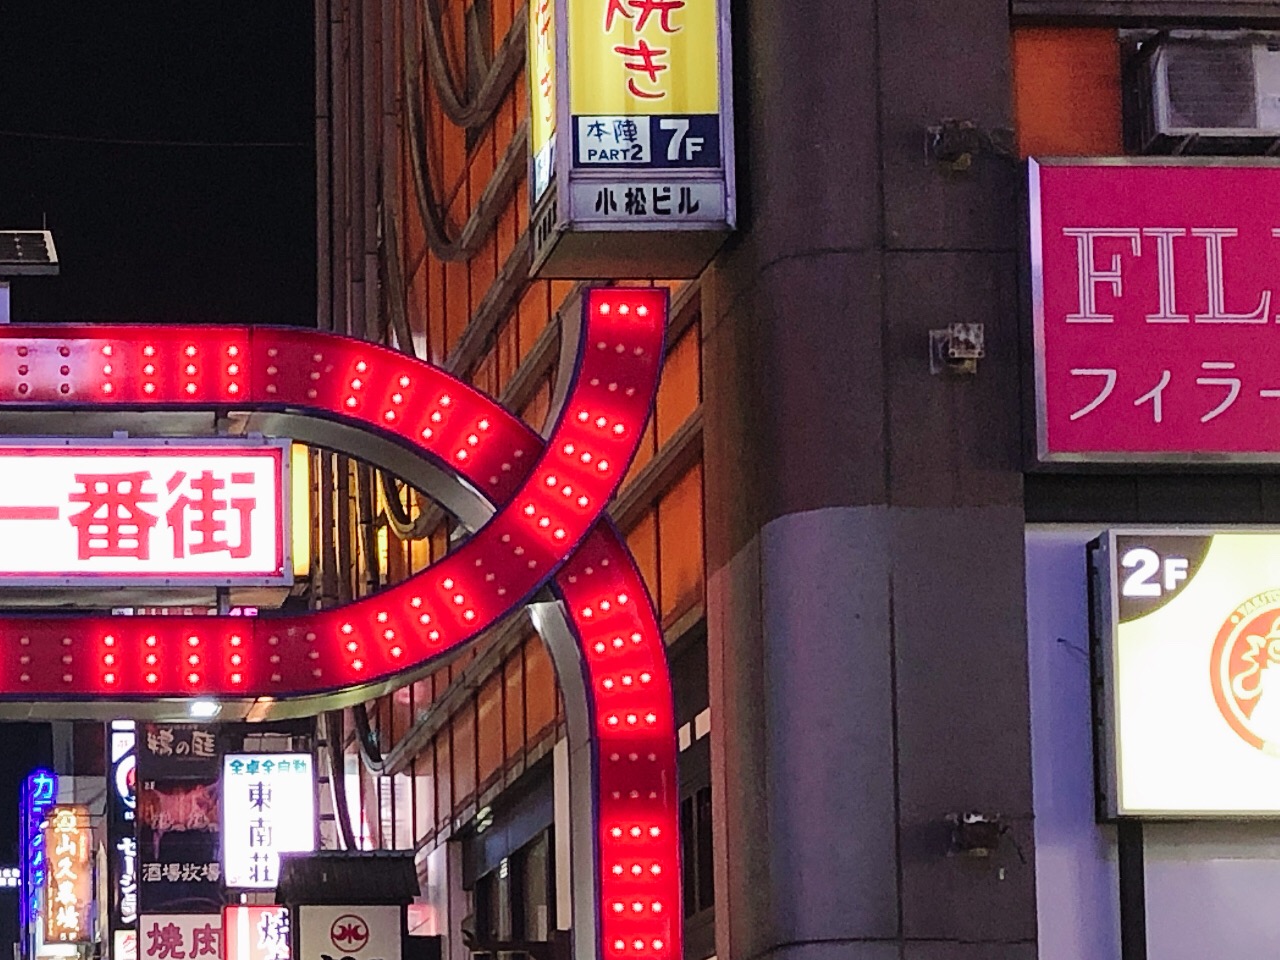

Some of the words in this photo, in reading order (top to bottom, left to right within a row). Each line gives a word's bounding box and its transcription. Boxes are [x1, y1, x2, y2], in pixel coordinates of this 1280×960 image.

[587, 121, 638, 144] 本陣
[659, 119, 705, 161] 7F
[587, 144, 643, 161] PART2
[595, 186, 700, 216] 小松ビル
[1063, 227, 1280, 323] FIL
[1122, 547, 1189, 597] 2F
[146, 922, 221, 959] 焼肉
